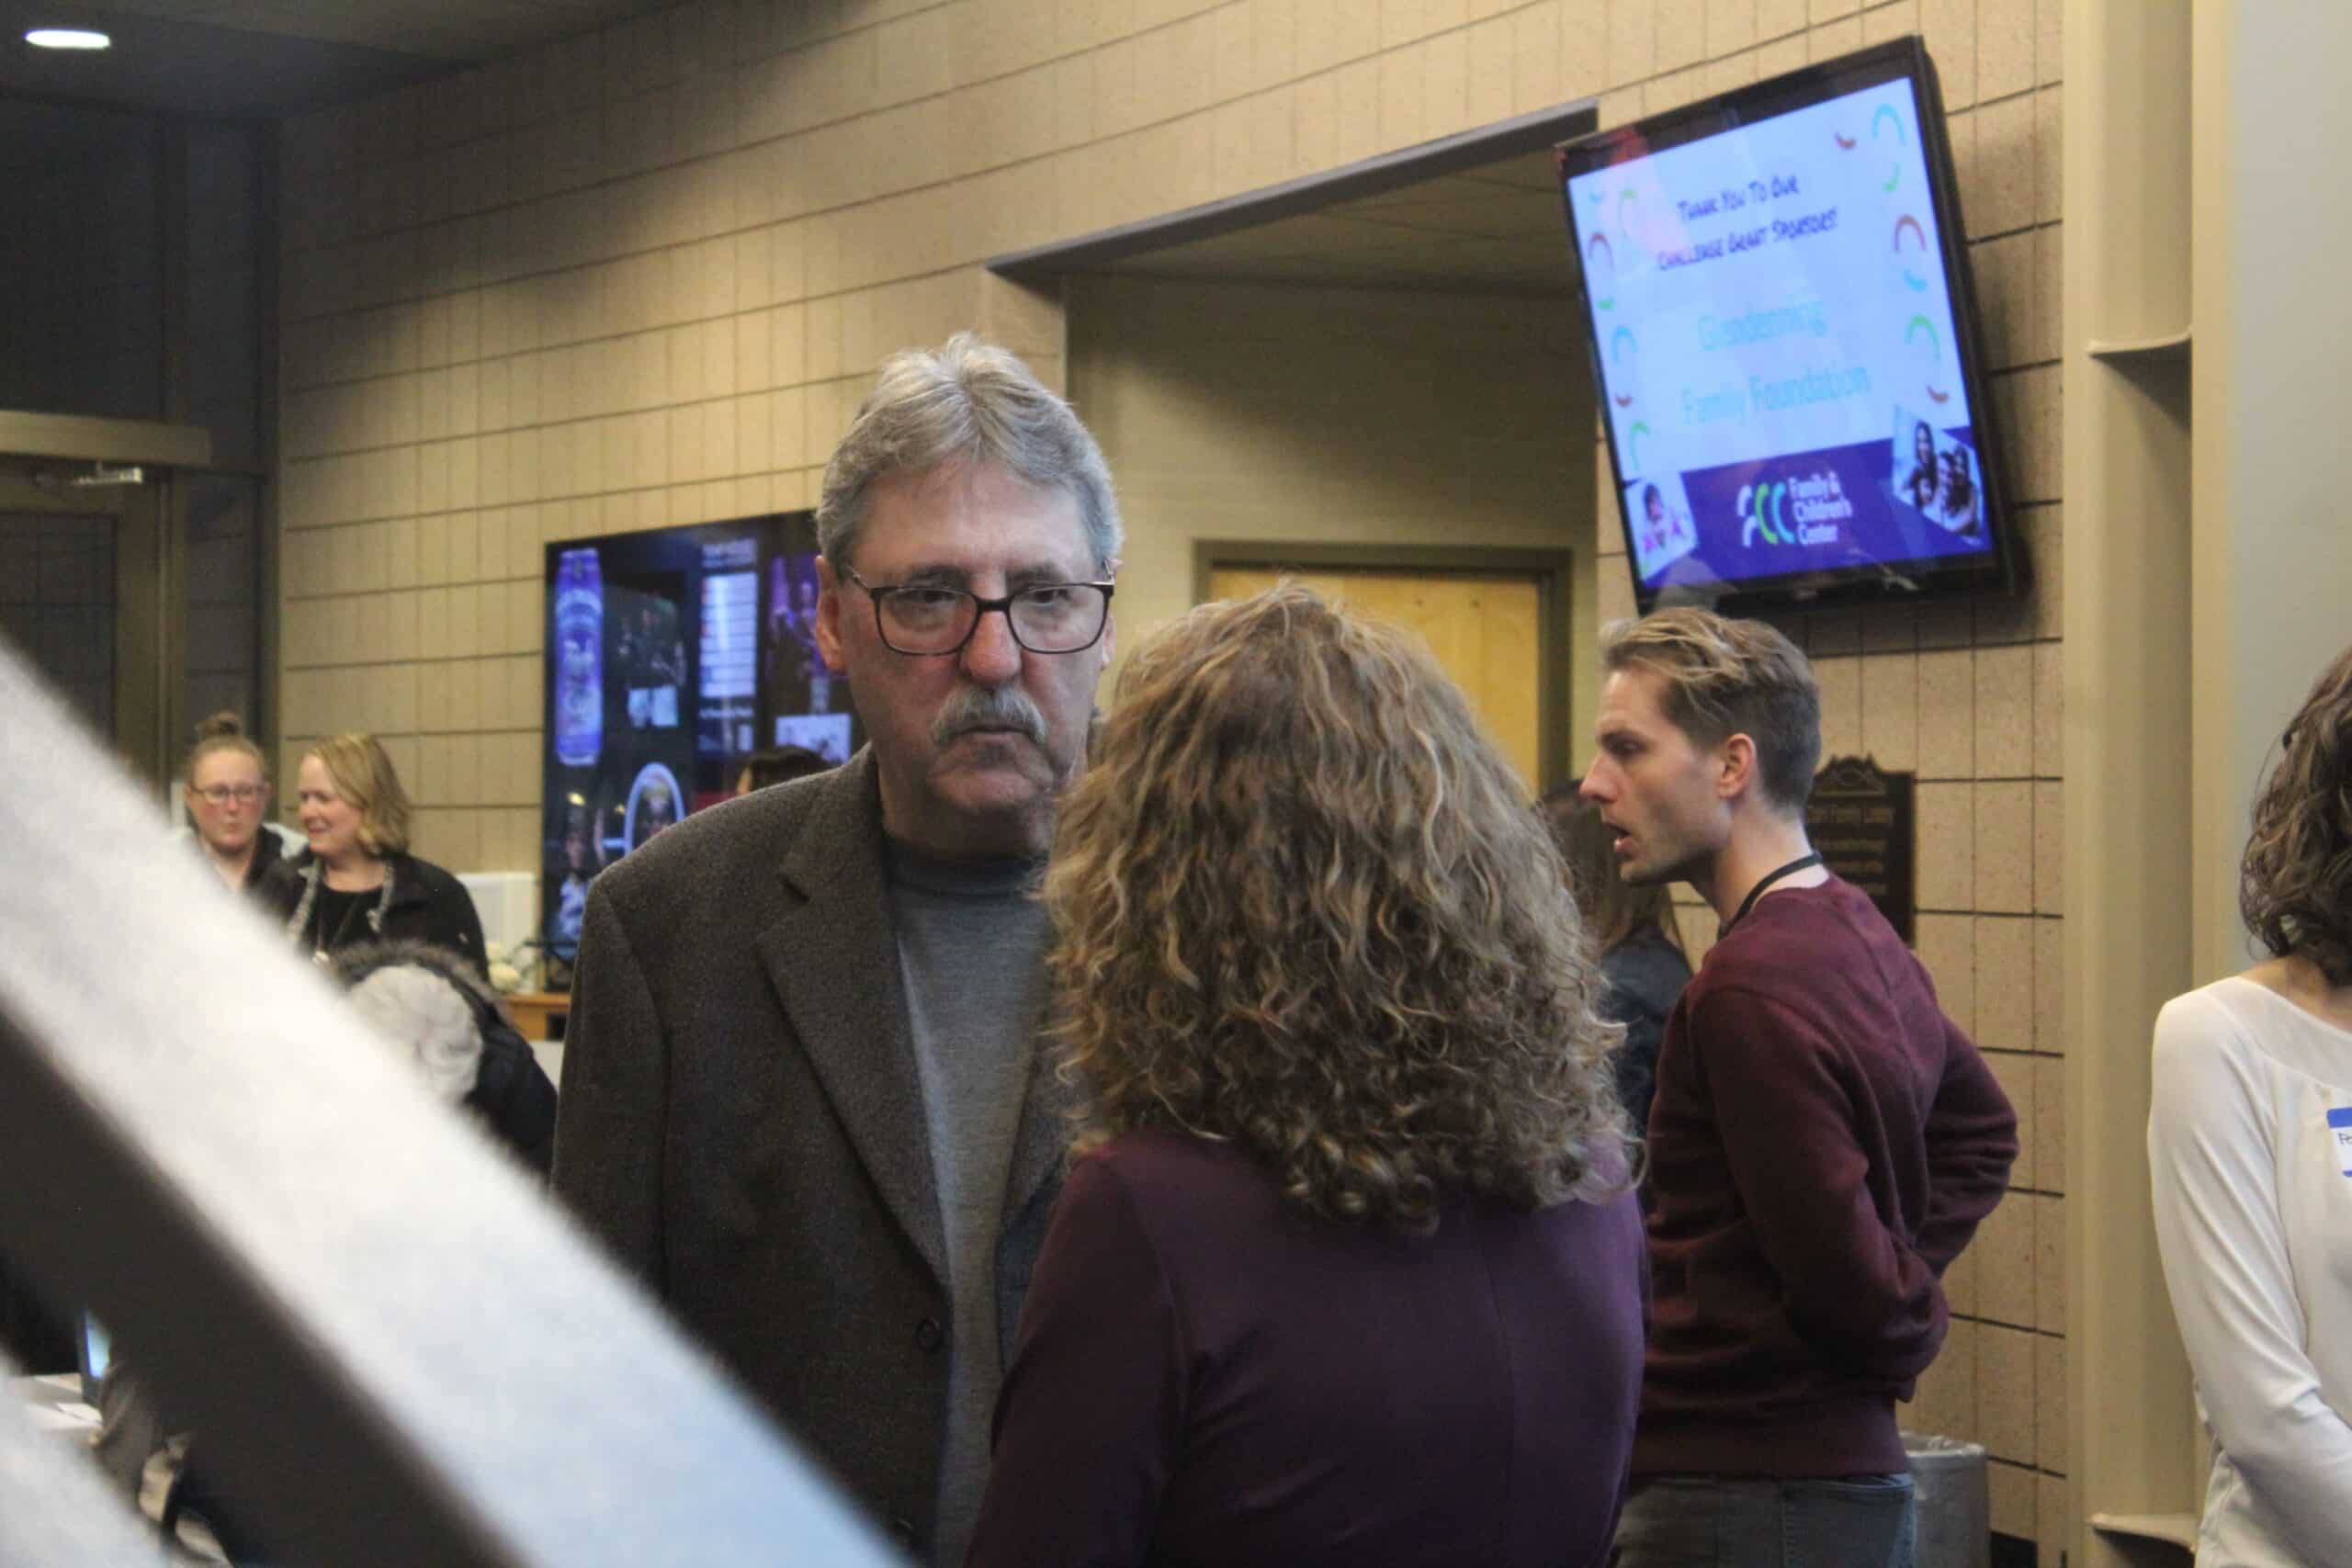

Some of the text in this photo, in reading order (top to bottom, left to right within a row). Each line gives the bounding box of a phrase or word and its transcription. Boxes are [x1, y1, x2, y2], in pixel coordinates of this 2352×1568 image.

[1677, 175, 1799, 223] THANK YOU TO OUR
[1657, 238, 1724, 270] CHALLENGE
[1727, 227, 1768, 253] GRANT
[1681, 364, 1871, 426] Family Foundation
[1789, 473, 1828, 500] Family
[1793, 496, 1853, 524] Children's
[1798, 522, 1838, 547] Center
